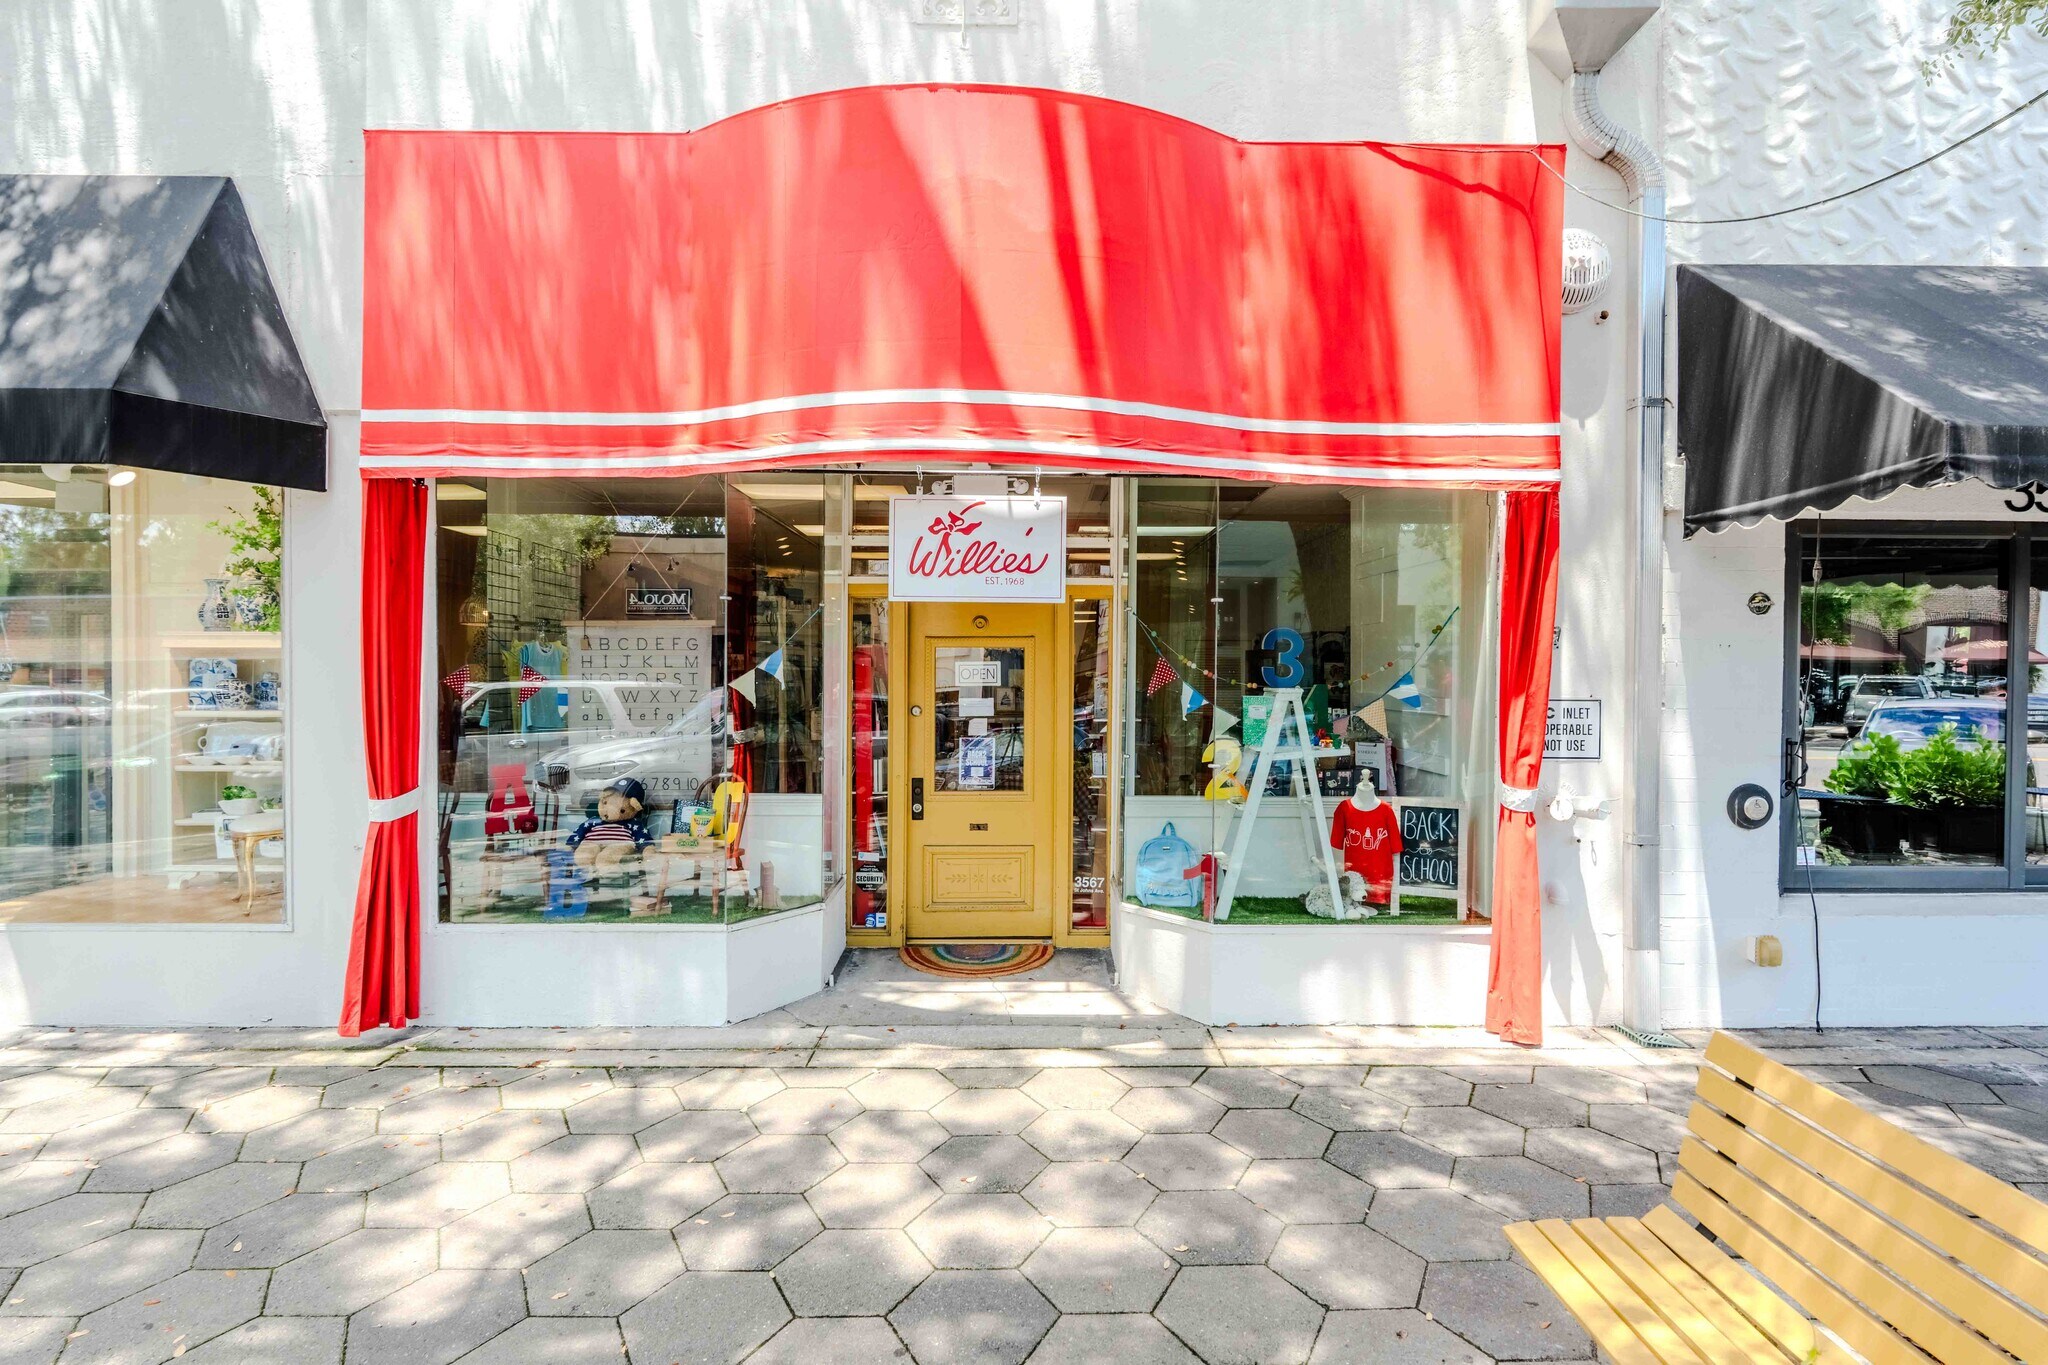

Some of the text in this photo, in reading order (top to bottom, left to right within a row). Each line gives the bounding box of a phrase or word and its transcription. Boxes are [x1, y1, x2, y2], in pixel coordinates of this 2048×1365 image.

[985, 576, 1025, 586] EST. 1968
[1262, 627, 1304, 688] 3
[960, 668, 995, 680] OPEN
[1563, 707, 1590, 719] INLET
[1543, 739, 1586, 752] NOT USE
[1404, 809, 1454, 841] BACK
[1401, 855, 1455, 885] SCHOOL
[856, 875, 883, 883] SECURITY
[1074, 876, 1105, 888] 3567
